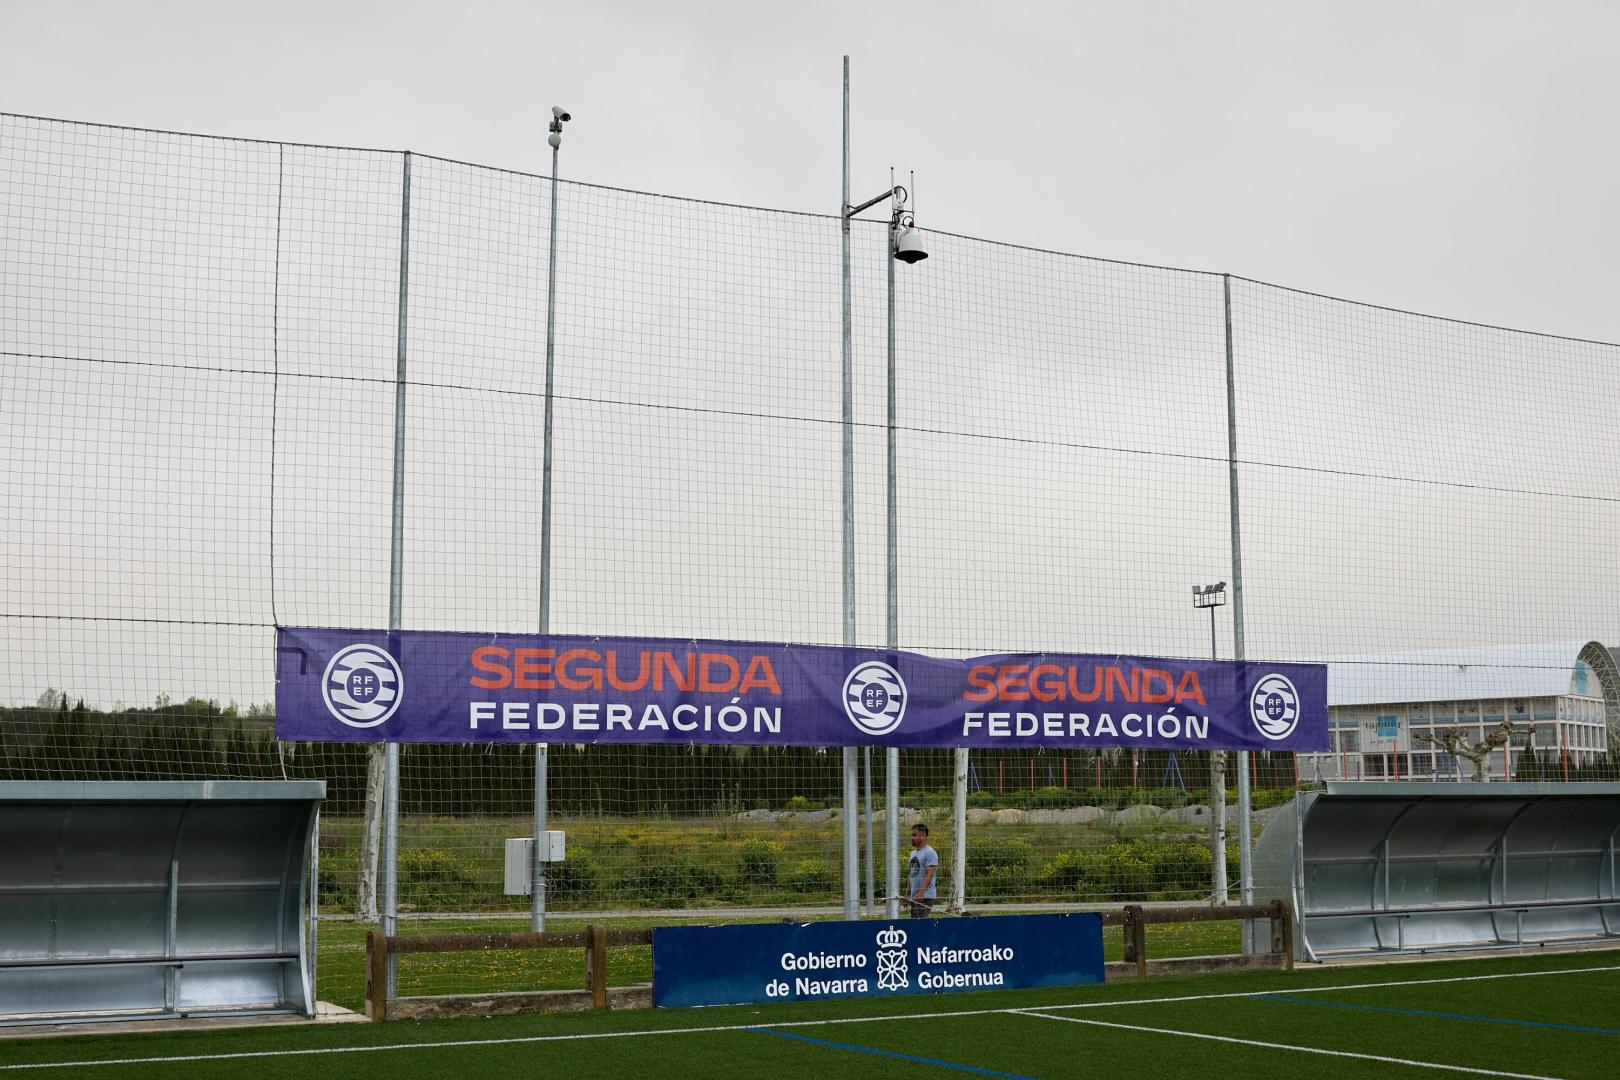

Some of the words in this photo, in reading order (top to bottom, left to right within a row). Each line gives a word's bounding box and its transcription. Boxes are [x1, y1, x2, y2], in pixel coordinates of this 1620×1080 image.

[352, 675, 374, 685] RF
[470, 646, 781, 695] SEGUNDA
[352, 687, 374, 696] EF
[866, 689, 884, 698] RF
[963, 664, 1206, 705] SEGUNDA
[866, 699, 884, 708] EF
[470, 697, 782, 733] FEDERACIÓN
[963, 707, 1209, 739] FEDERACIÓN
[781, 950, 867, 971] Gobierno
[917, 944, 1014, 964] Nafarroako
[765, 978, 790, 997] de
[796, 976, 868, 996] Navarra
[917, 970, 1004, 989] Gobernua
